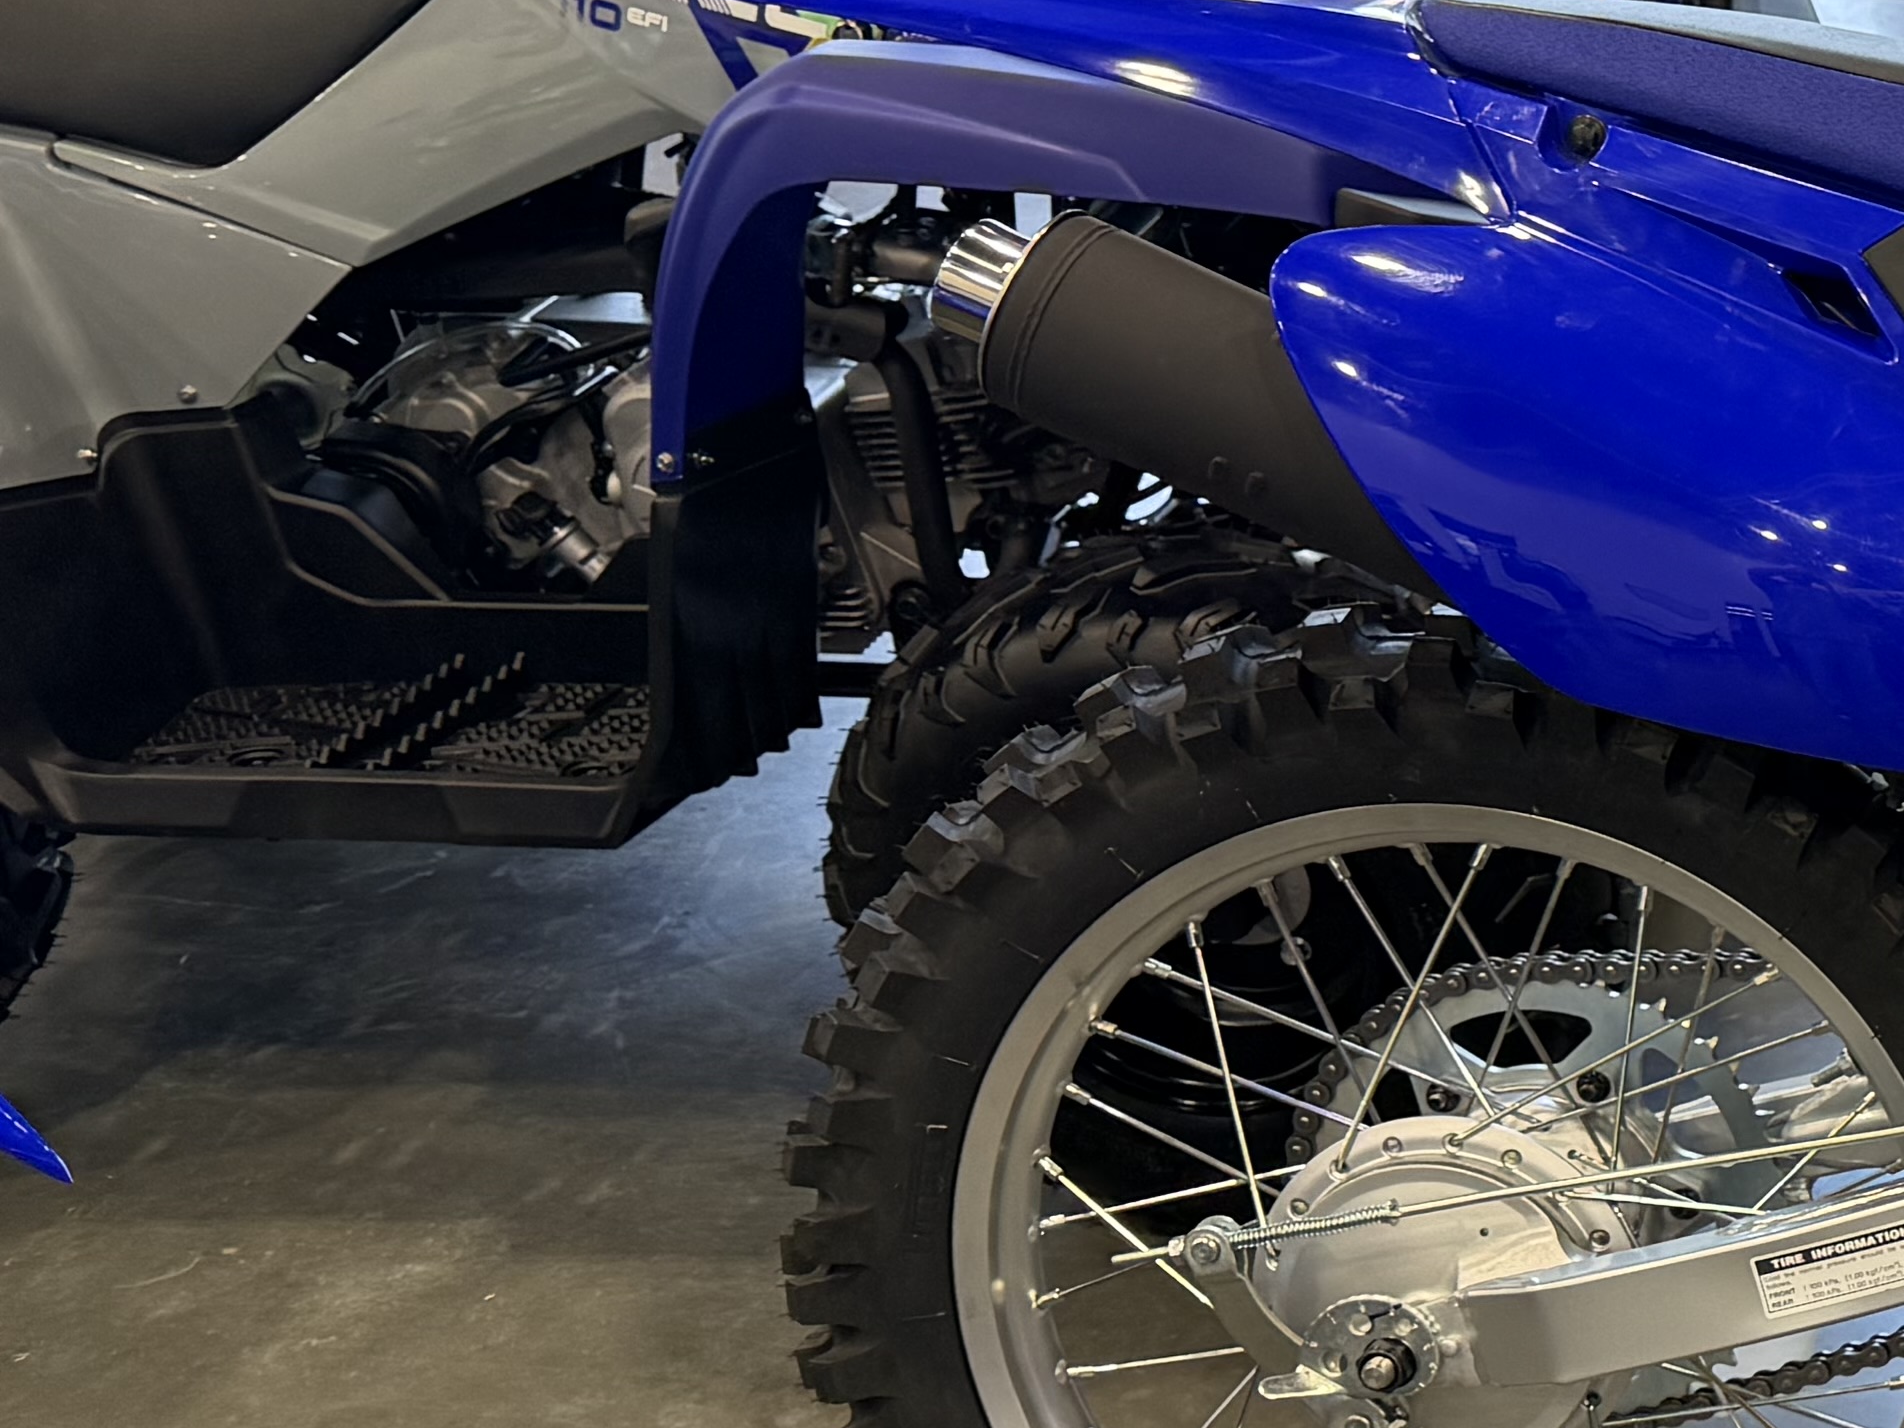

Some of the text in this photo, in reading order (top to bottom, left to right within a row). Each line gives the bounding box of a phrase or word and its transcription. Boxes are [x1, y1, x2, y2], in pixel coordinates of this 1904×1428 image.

[625, 6, 669, 33] EFI
[1770, 1253, 1806, 1270] TIRE
[1826, 1256, 1857, 1270] pressure
[1768, 1287, 1796, 1300] FRONT
[1771, 1297, 1795, 1309] REAR
